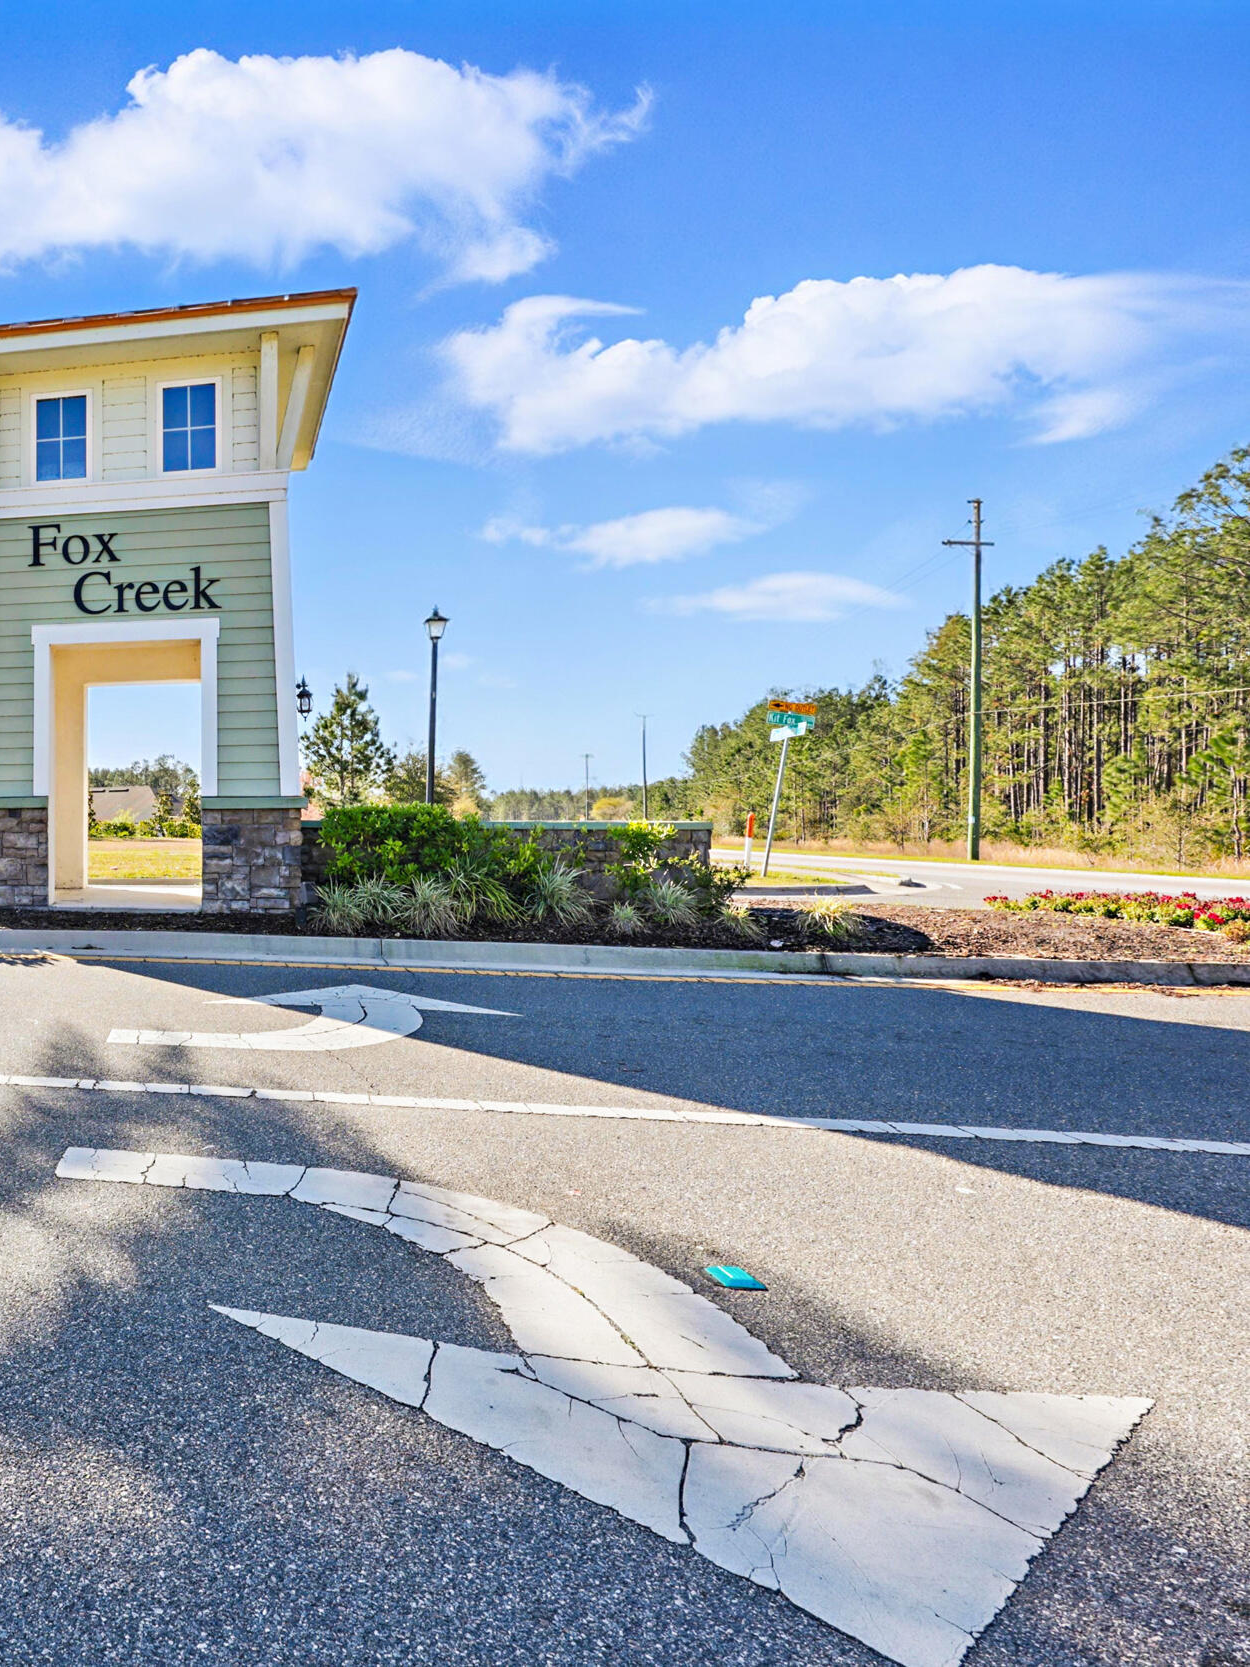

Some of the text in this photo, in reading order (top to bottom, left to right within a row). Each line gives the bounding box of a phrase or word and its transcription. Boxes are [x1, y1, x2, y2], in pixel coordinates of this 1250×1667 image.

[27, 523, 122, 568] Fox
[73, 565, 223, 615] Creek
[768, 713, 780, 723] Kit
[782, 714, 796, 725] Fox
